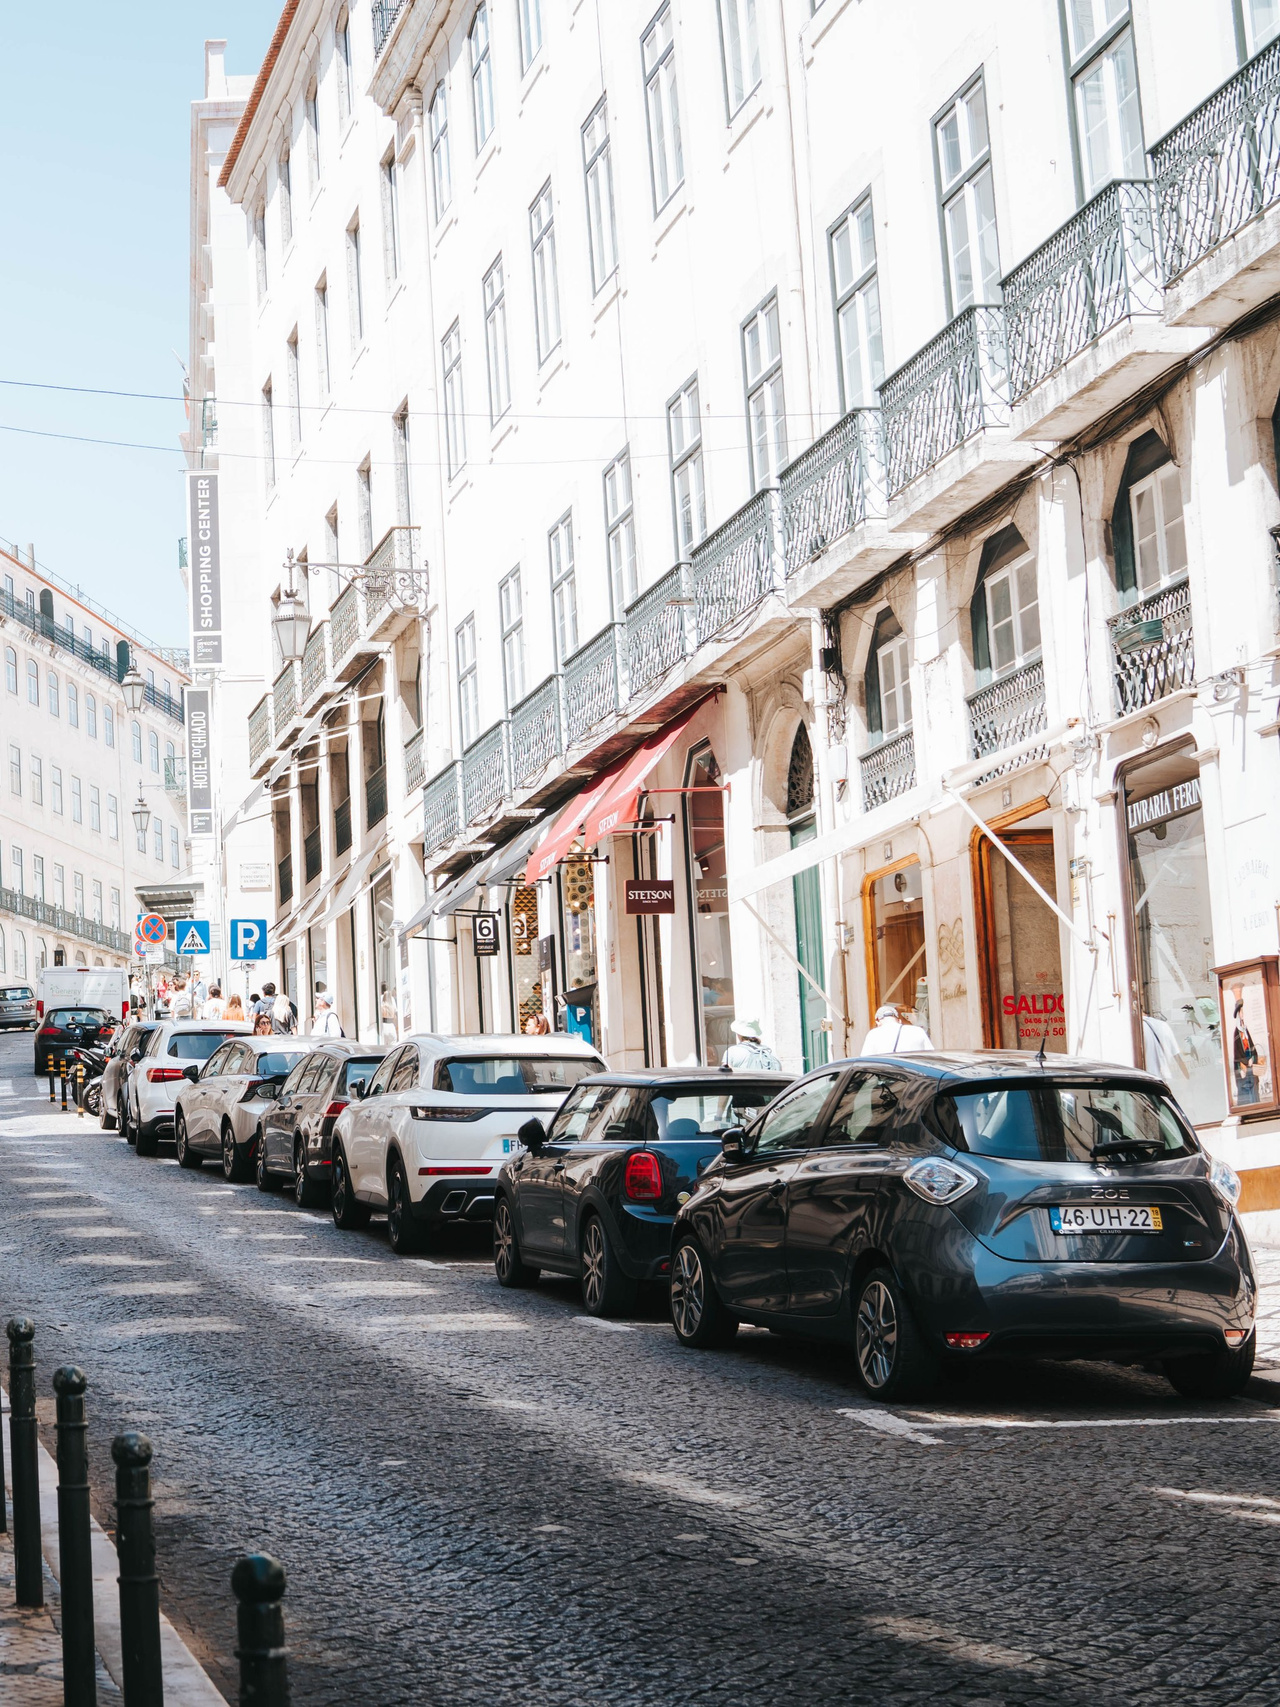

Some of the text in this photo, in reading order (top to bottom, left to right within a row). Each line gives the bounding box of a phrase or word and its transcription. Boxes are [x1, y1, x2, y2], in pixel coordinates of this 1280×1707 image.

[198, 479, 211, 541] CENTER
[199, 545, 213, 628] SHOPPING
[191, 711, 207, 748] CHIADO
[192, 757, 208, 789] HOTEL
[598, 811, 619, 836] STETSON
[1127, 790, 1172, 829] LIVRARIA
[628, 890, 672, 900] STETSON
[237, 922, 260, 957] P
[478, 919, 491, 937] 6
[1020, 1028, 1040, 1037] 30%
[1053, 1027, 1066, 1036] 50
[1090, 1188, 1130, 1199] ZOE
